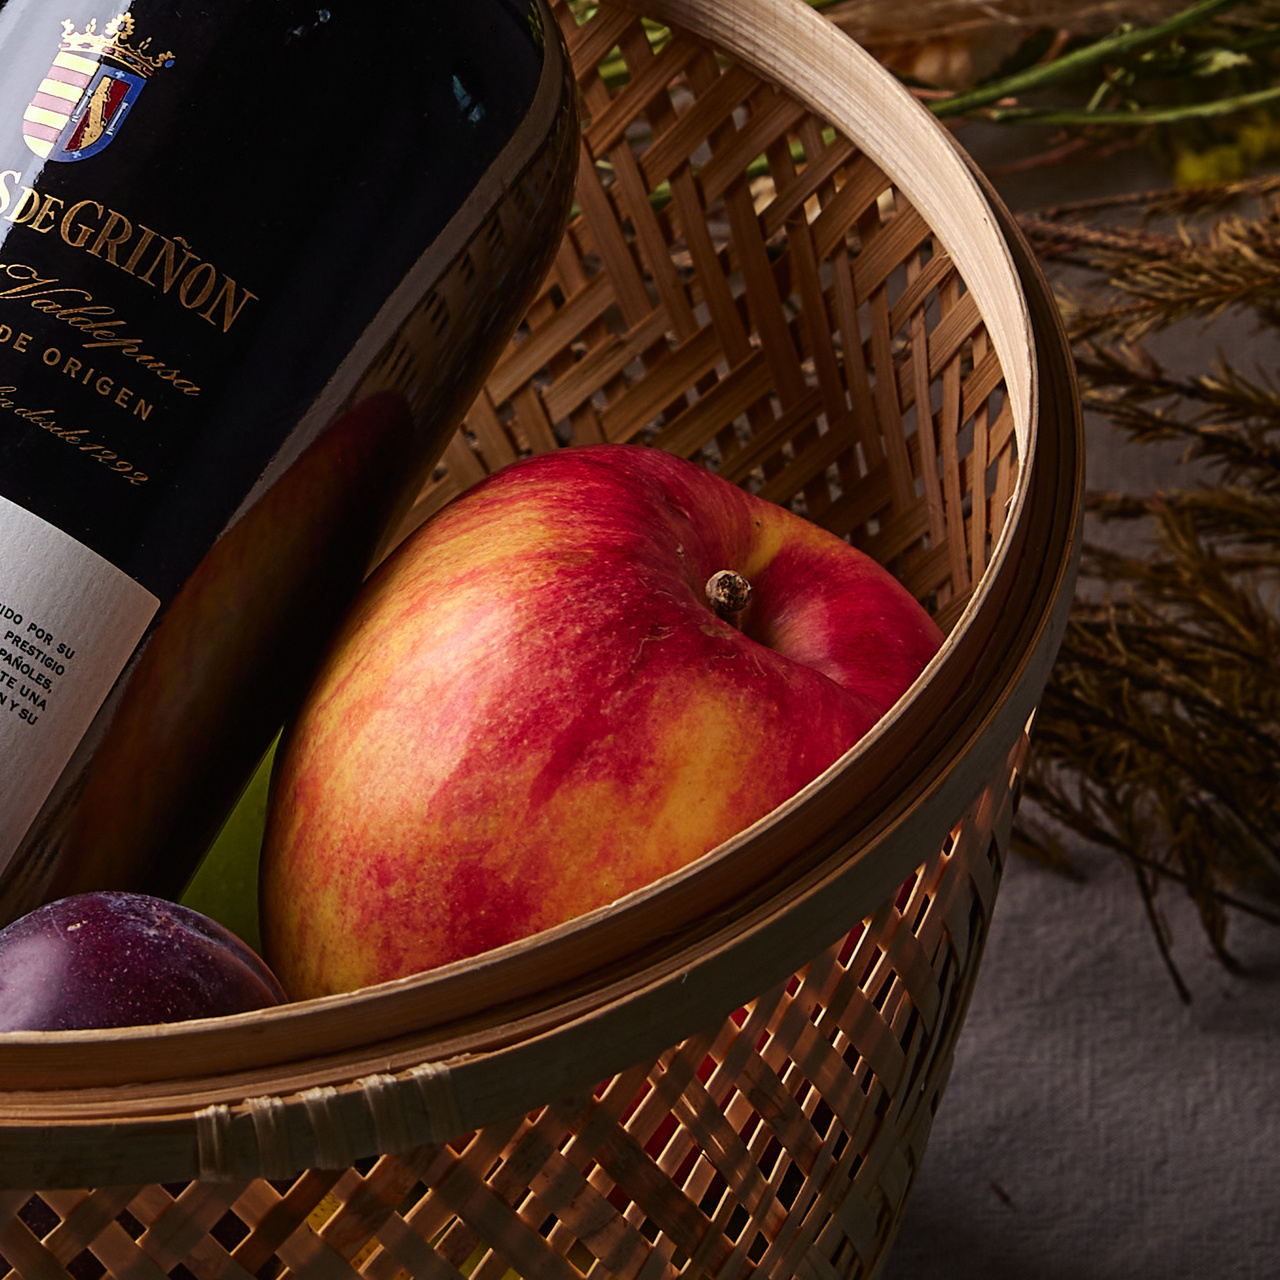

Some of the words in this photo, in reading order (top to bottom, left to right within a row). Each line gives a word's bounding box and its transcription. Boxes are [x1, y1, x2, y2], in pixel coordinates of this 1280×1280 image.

[4, 185, 63, 234] DE
[60, 200, 259, 333] GRIÑON
[42, 347, 153, 420] ORIGEN
[14, 409, 90, 444] desde
[79, 443, 148, 485] 1292
[4, 630, 65, 676] PRESTIGIO
[27, 622, 53, 645] POR
[57, 642, 75, 660] SU
[10, 699, 19, 712] Y
[18, 709, 39, 726] SU
[20, 684, 47, 711] UNA
